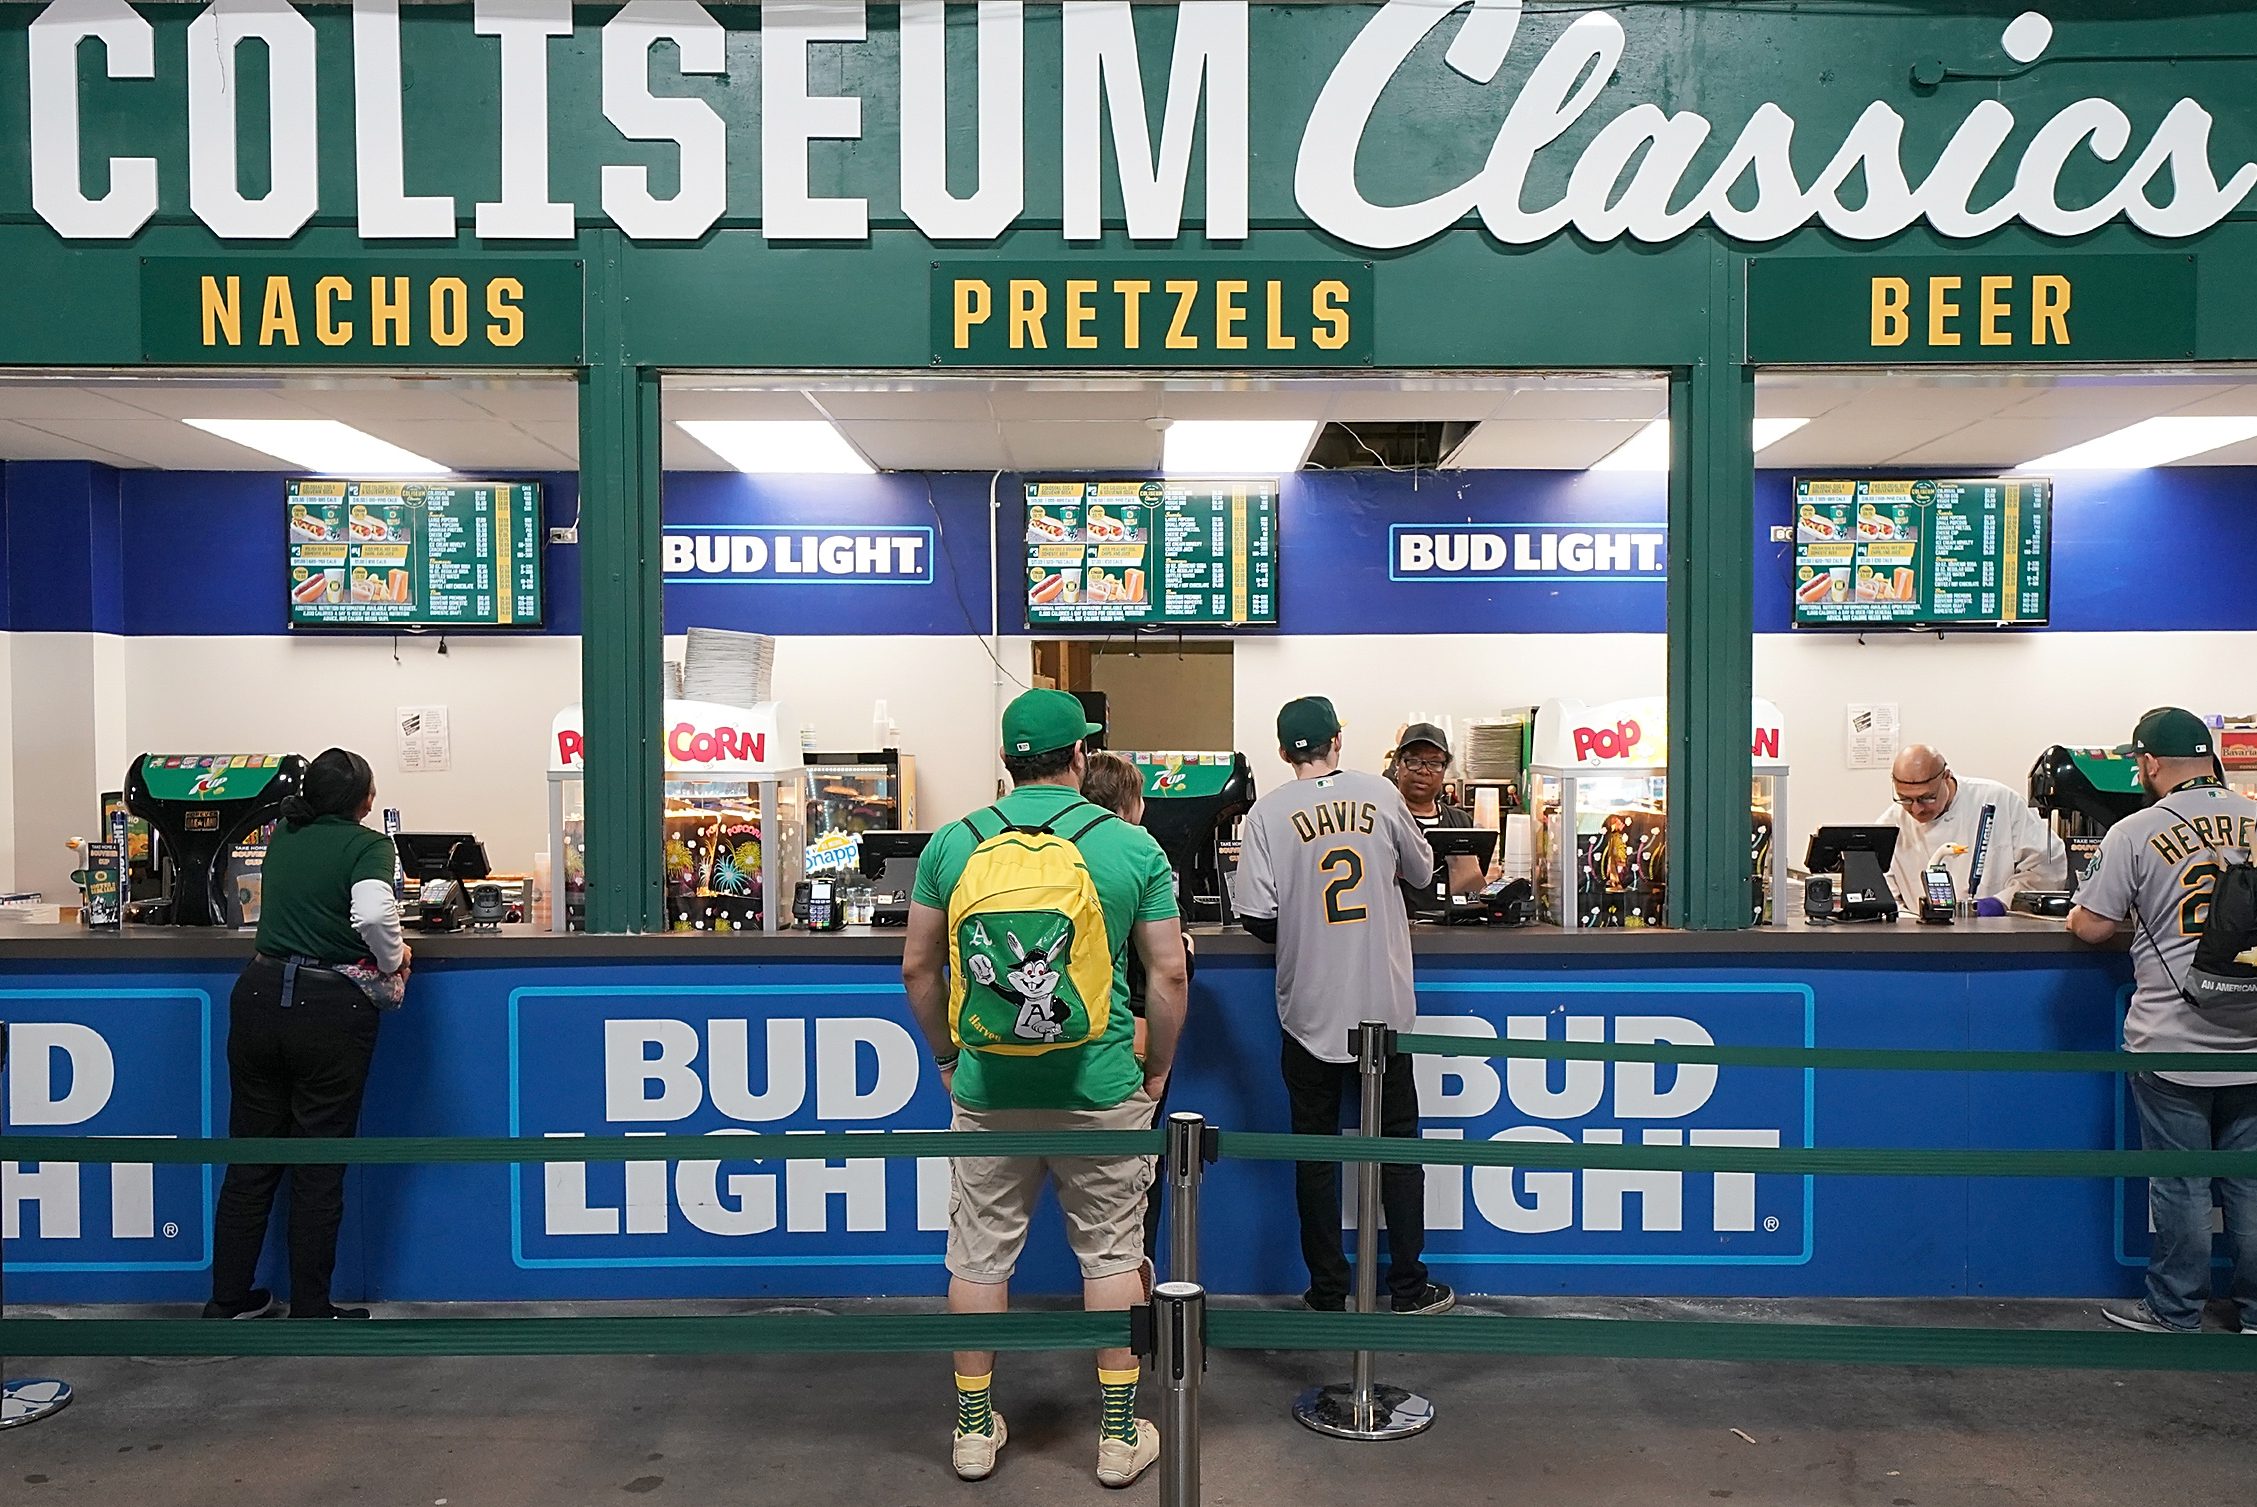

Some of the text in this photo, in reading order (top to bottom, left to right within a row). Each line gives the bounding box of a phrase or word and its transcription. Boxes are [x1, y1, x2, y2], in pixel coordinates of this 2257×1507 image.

[28, 0, 2257, 249] COLISEUM Classics
[202, 276, 524, 346] NACHOS
[954, 279, 1349, 350] PRETZELS
[1871, 275, 2071, 346] BEER
[662, 535, 768, 573] BUD
[1400, 533, 1507, 571] BUD
[668, 722, 765, 763] CORN
[1573, 719, 1641, 762] POP
[1289, 800, 1377, 843] DAVIS
[1318, 845, 1367, 925] 2
[969, 920, 993, 946] A
[2201, 979, 2215, 990] AN
[605, 1017, 919, 1122] BUD
[1412, 1015, 1719, 1119] BUD
